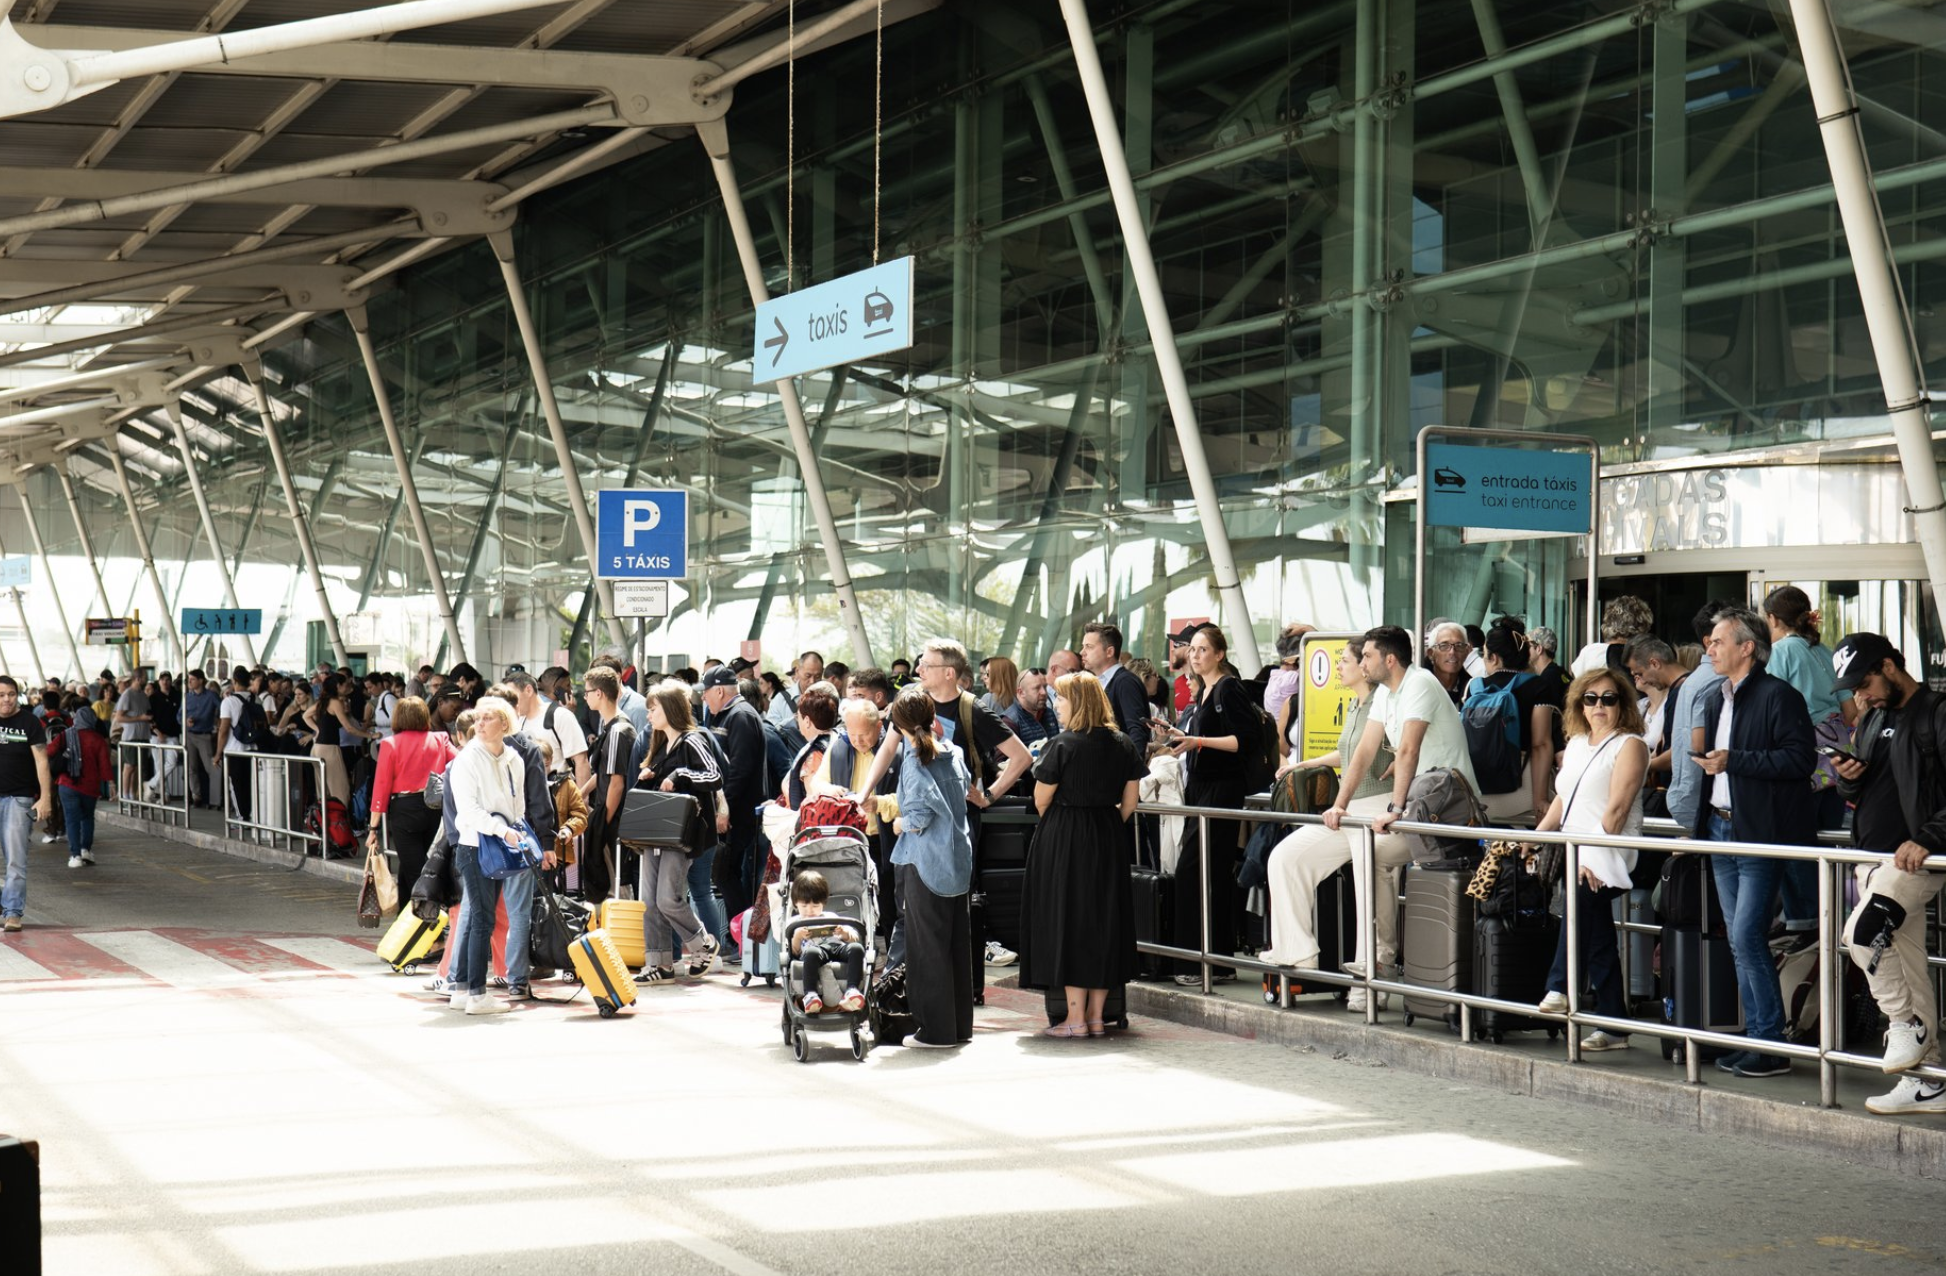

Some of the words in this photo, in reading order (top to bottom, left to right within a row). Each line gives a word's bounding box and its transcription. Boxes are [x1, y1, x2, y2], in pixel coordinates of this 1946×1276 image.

[808, 303, 848, 342] taxis
[1481, 475, 1539, 490] entrada
[1544, 475, 1577, 492] táxis
[1481, 493, 1508, 508] taxi
[1512, 495, 1577, 511] entrance
[623, 499, 661, 547] P
[613, 556, 622, 569] 5
[626, 553, 671, 569] TÁXIS
